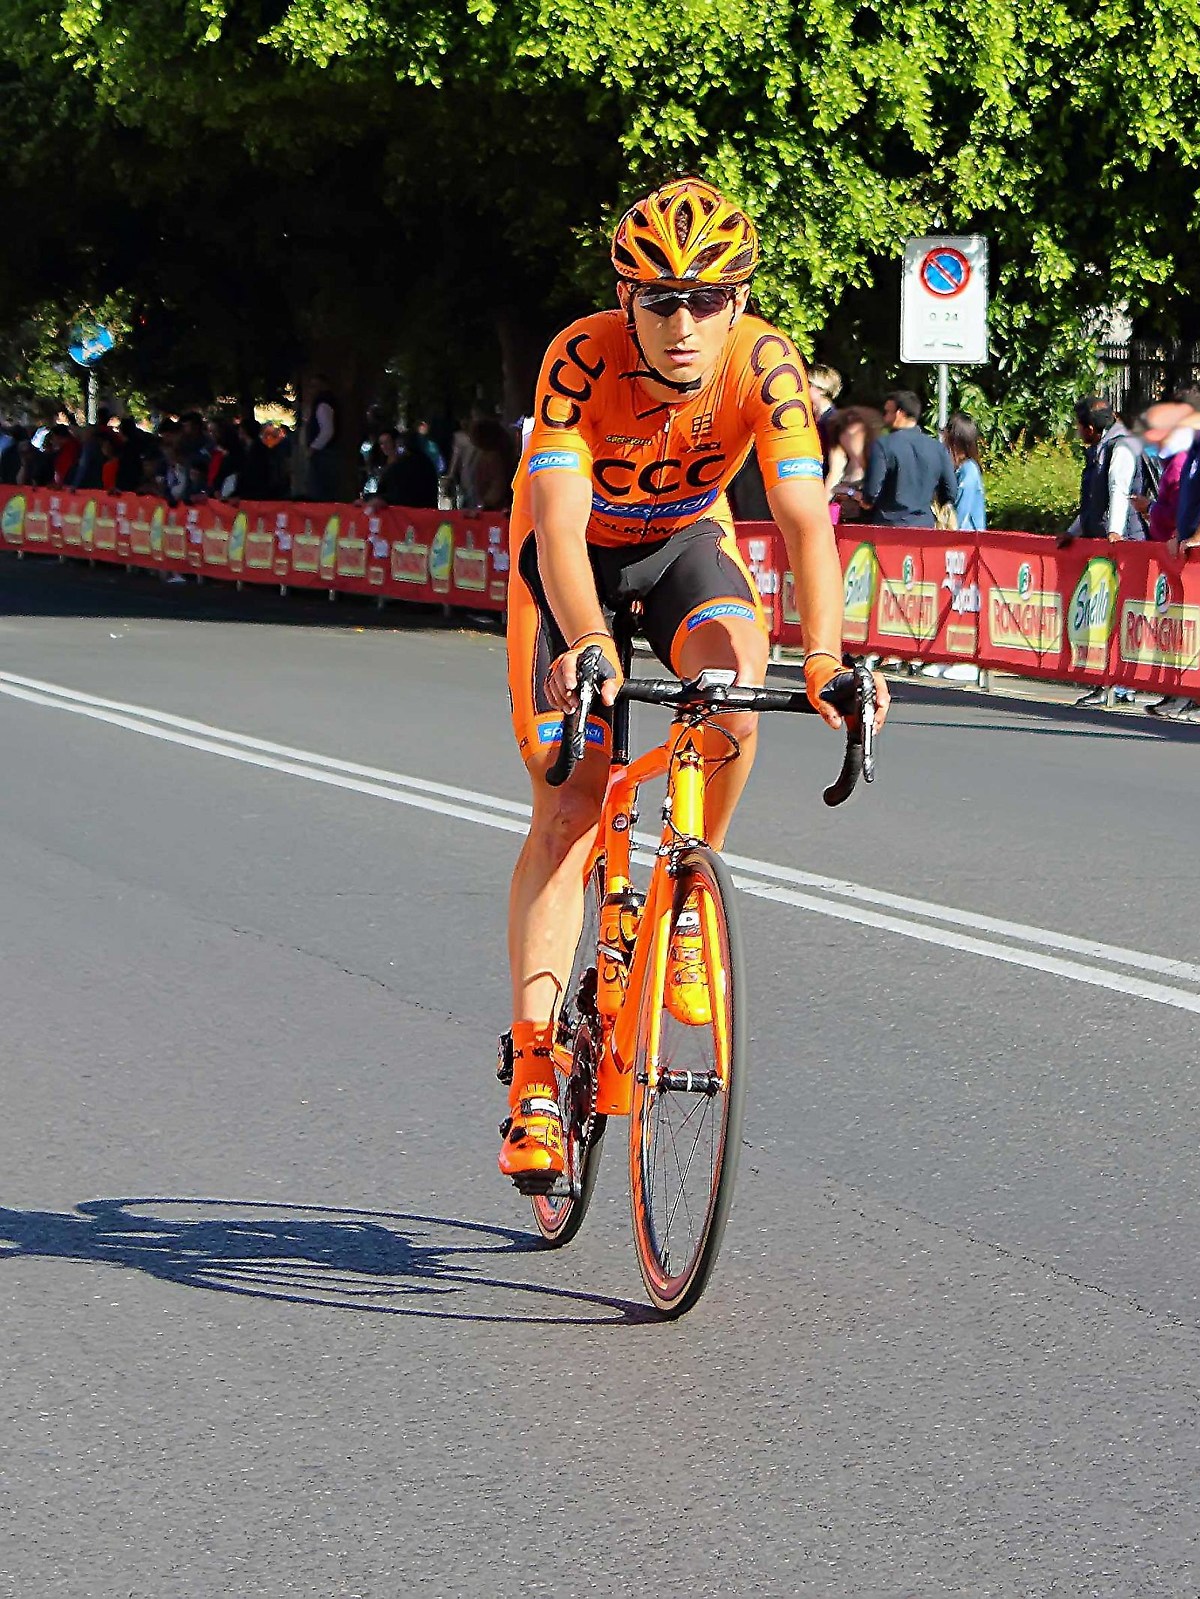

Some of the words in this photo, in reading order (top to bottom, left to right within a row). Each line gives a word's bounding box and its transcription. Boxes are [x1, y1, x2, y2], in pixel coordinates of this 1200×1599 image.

[541, 333, 606, 429] CCC
[751, 334, 810, 430] CCC
[593, 454, 726, 496] CCC
